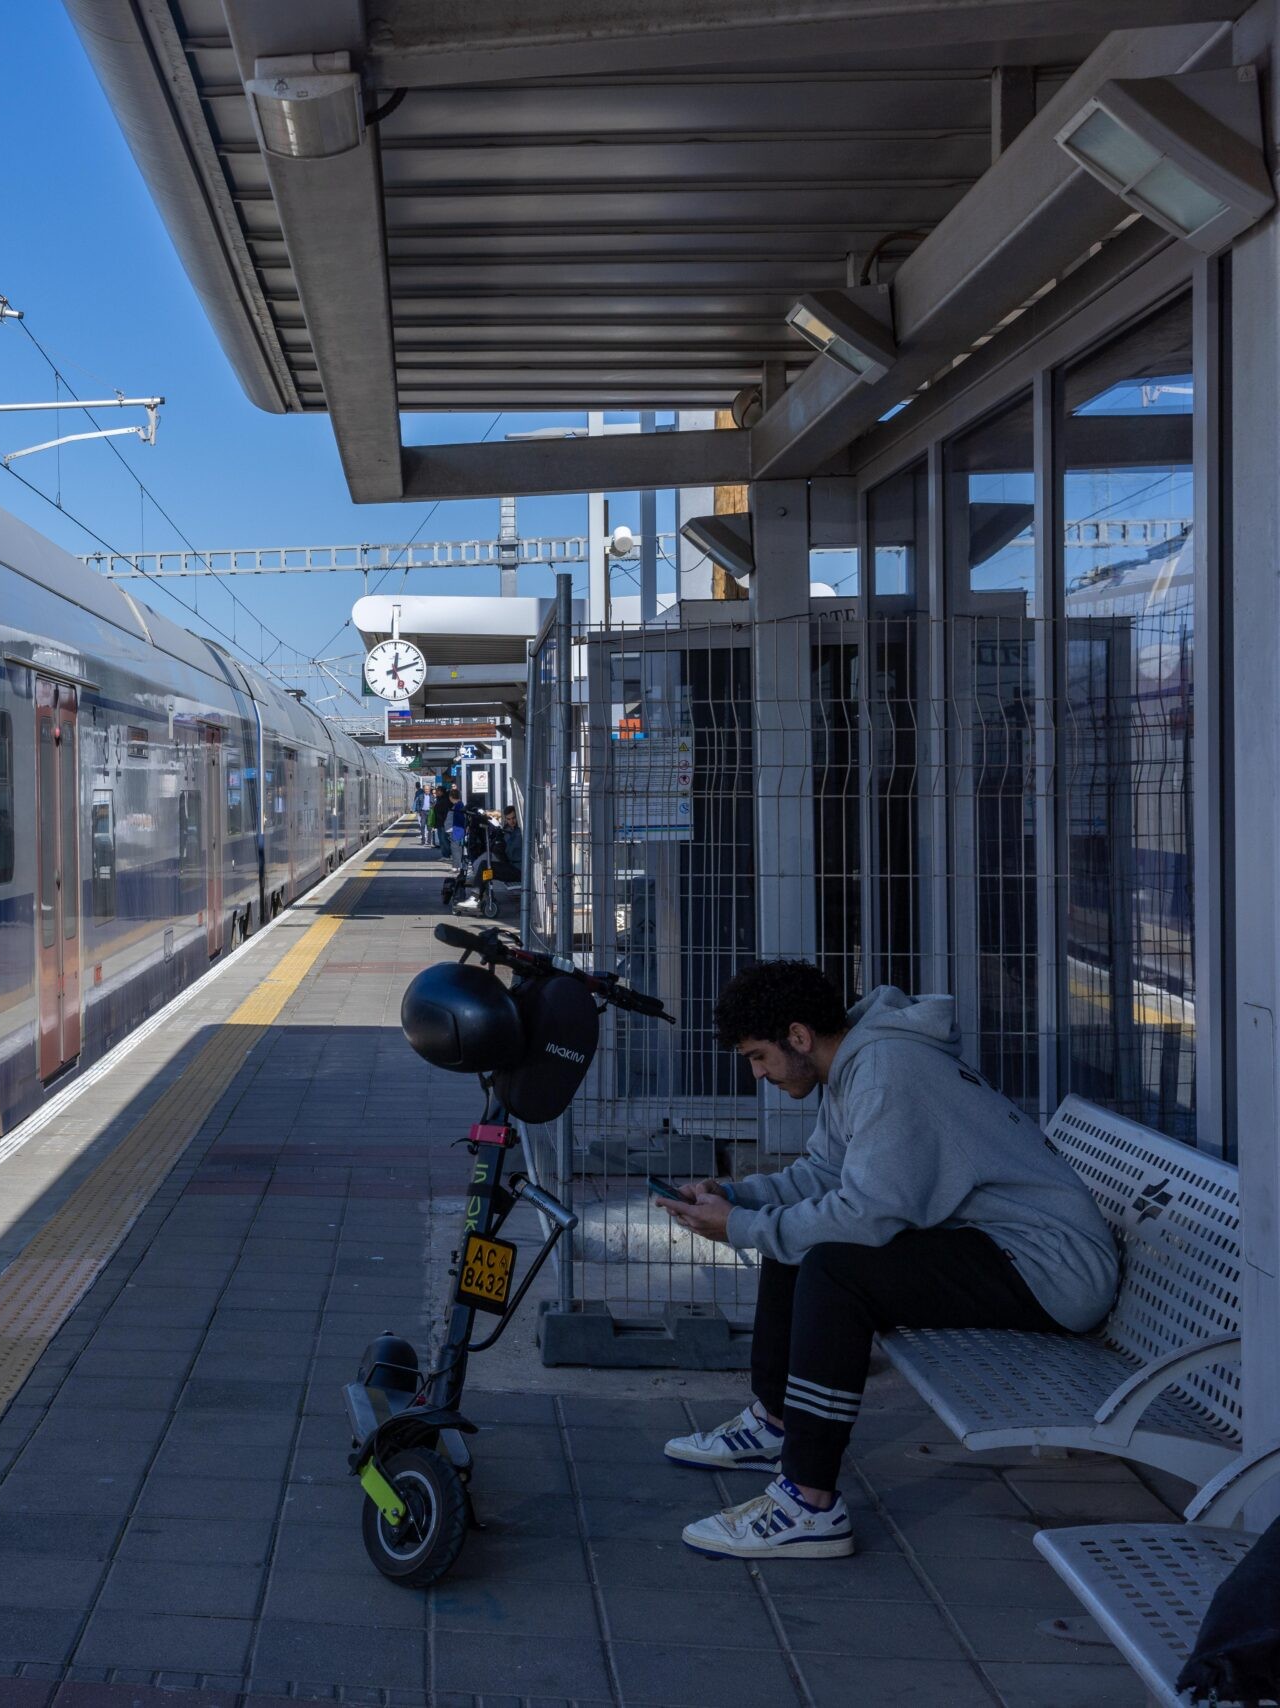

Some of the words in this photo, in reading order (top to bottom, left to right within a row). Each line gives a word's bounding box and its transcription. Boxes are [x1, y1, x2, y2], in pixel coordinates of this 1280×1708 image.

[545, 1042, 585, 1063] INOKIM
[473, 1245, 497, 1268] AC
[464, 1267, 505, 1297] 8432
